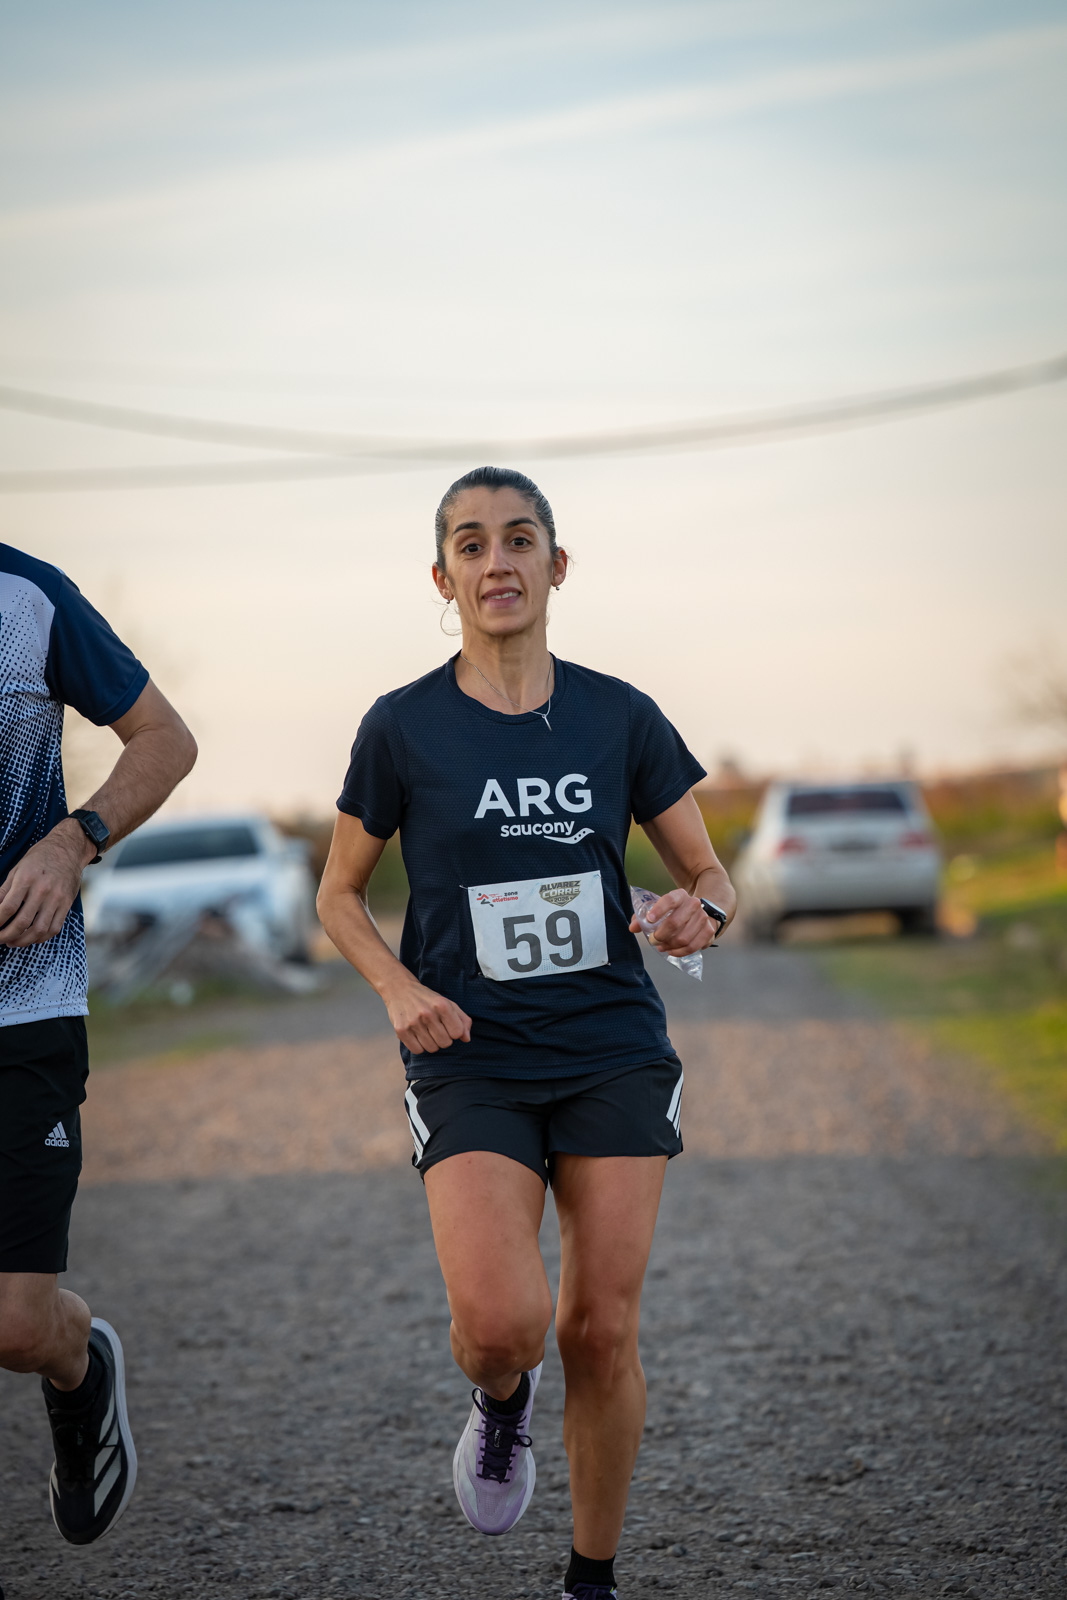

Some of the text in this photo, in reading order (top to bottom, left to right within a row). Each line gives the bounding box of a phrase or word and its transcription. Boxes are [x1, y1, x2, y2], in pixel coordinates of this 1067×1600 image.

[474, 773, 593, 818] ARG
[500, 821, 575, 838] saucony
[540, 880, 581, 892] ALVAREZ
[542, 887, 580, 898] CORRE
[502, 909, 583, 973] 59
[44, 1137, 70, 1148] adidas
